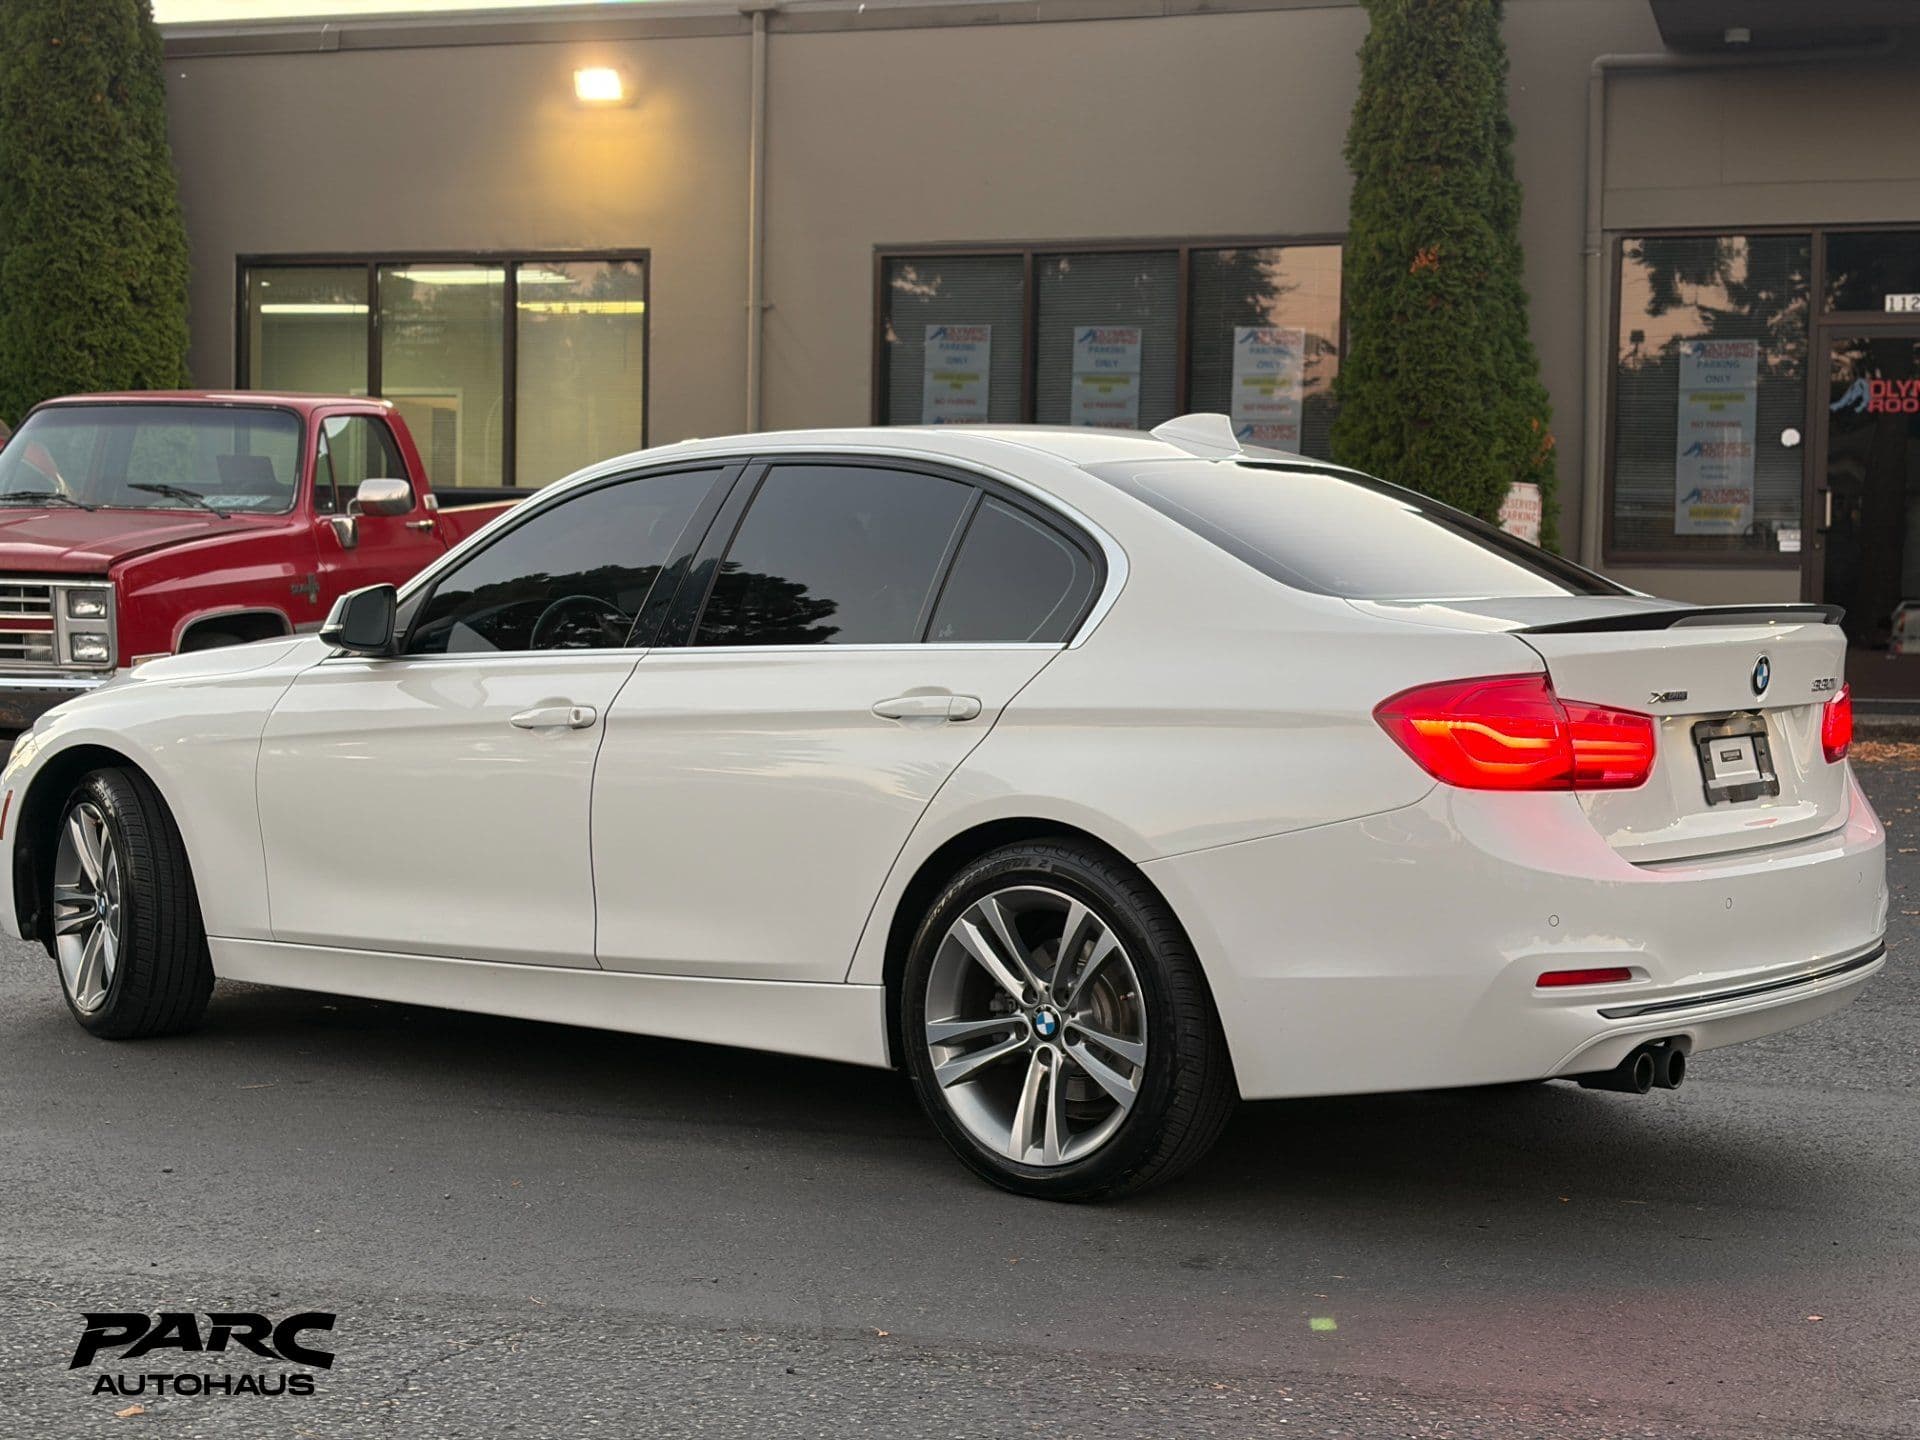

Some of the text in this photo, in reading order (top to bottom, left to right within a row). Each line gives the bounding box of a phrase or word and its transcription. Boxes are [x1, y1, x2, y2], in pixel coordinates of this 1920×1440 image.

[1697, 360, 1741, 368] PARKING
[1705, 375, 1731, 384] ONLY
[1504, 499, 1537, 511] ESERVED
[1501, 509, 1537, 522] PARKING
